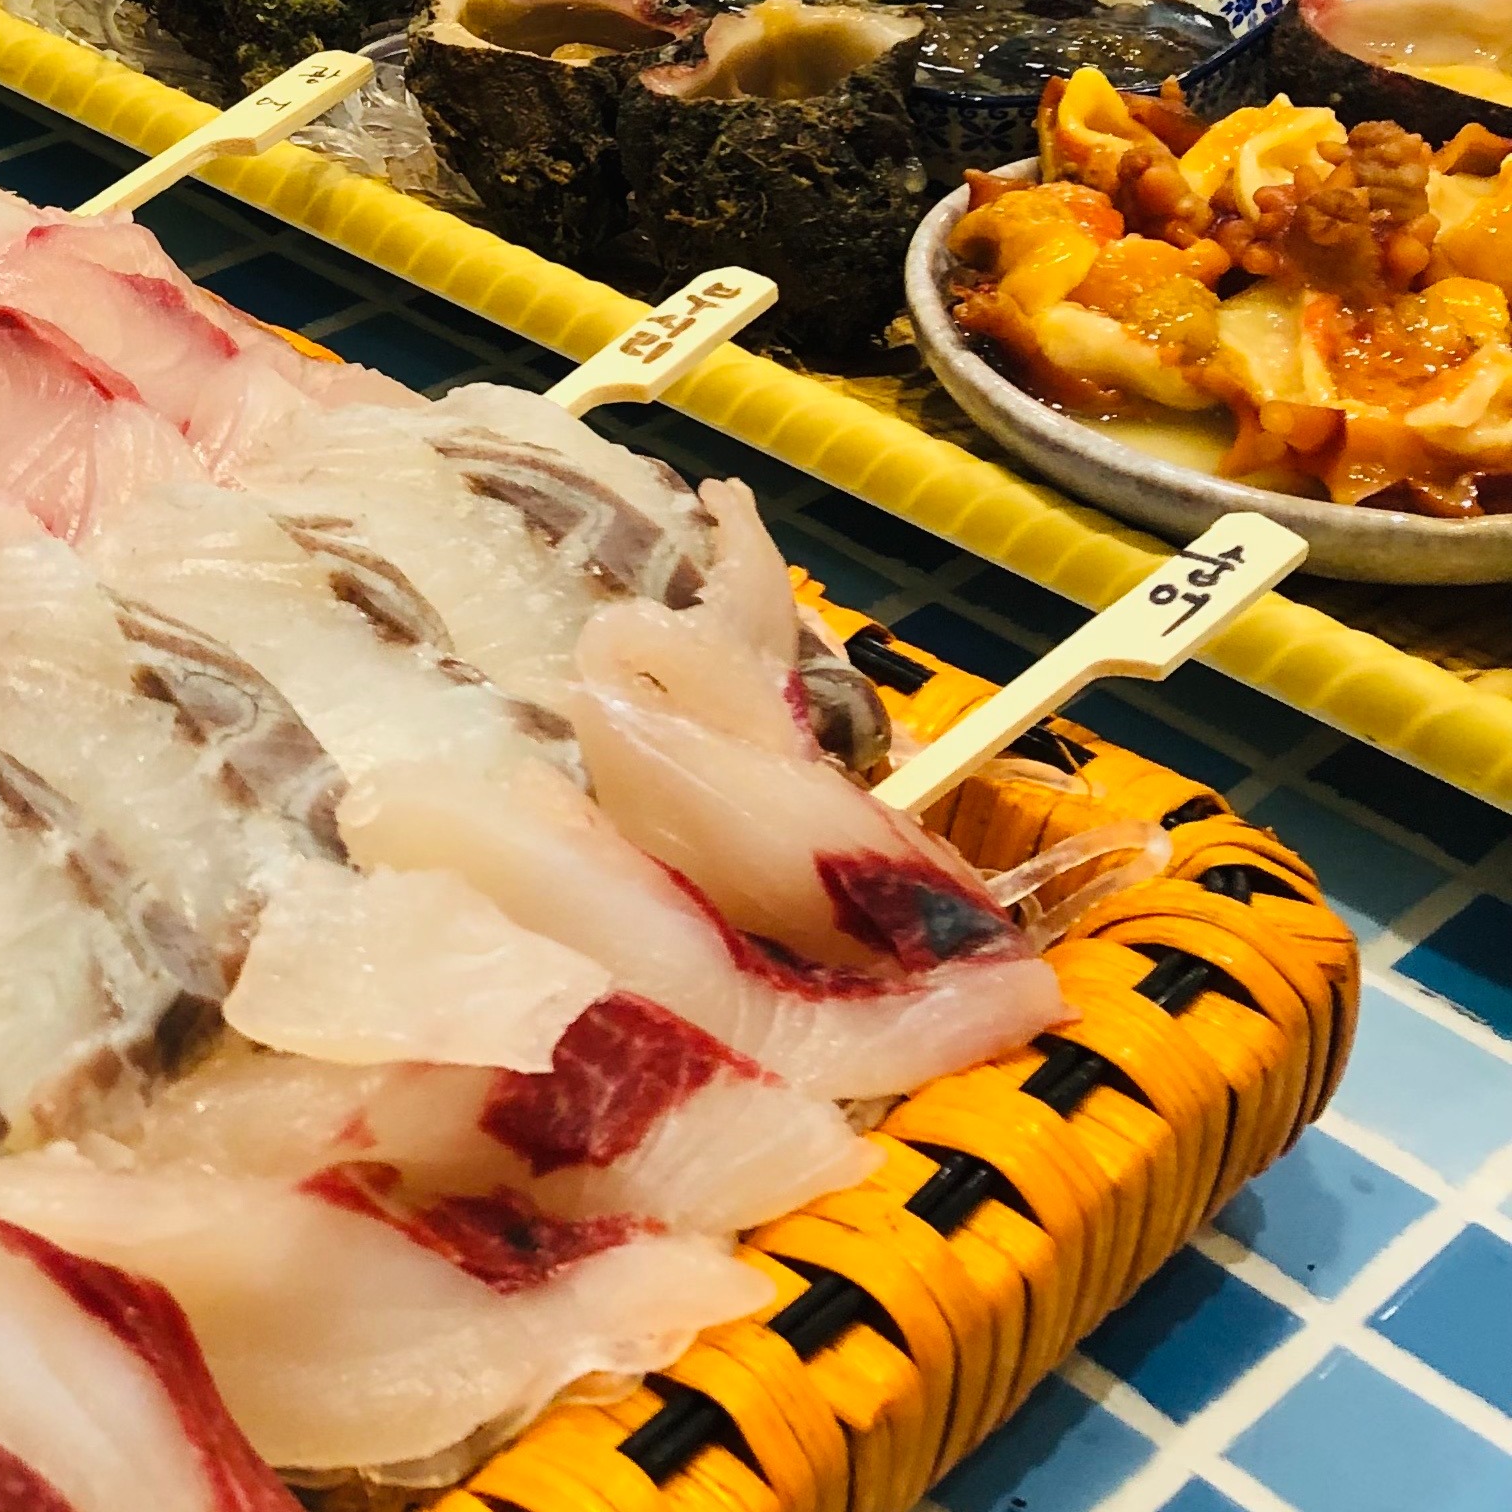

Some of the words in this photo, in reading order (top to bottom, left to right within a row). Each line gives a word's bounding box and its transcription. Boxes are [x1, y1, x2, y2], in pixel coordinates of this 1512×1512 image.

[256, 65, 341, 112] 광어
[619, 282, 742, 364] 부시리
[1149, 545, 1245, 637] 숭어
